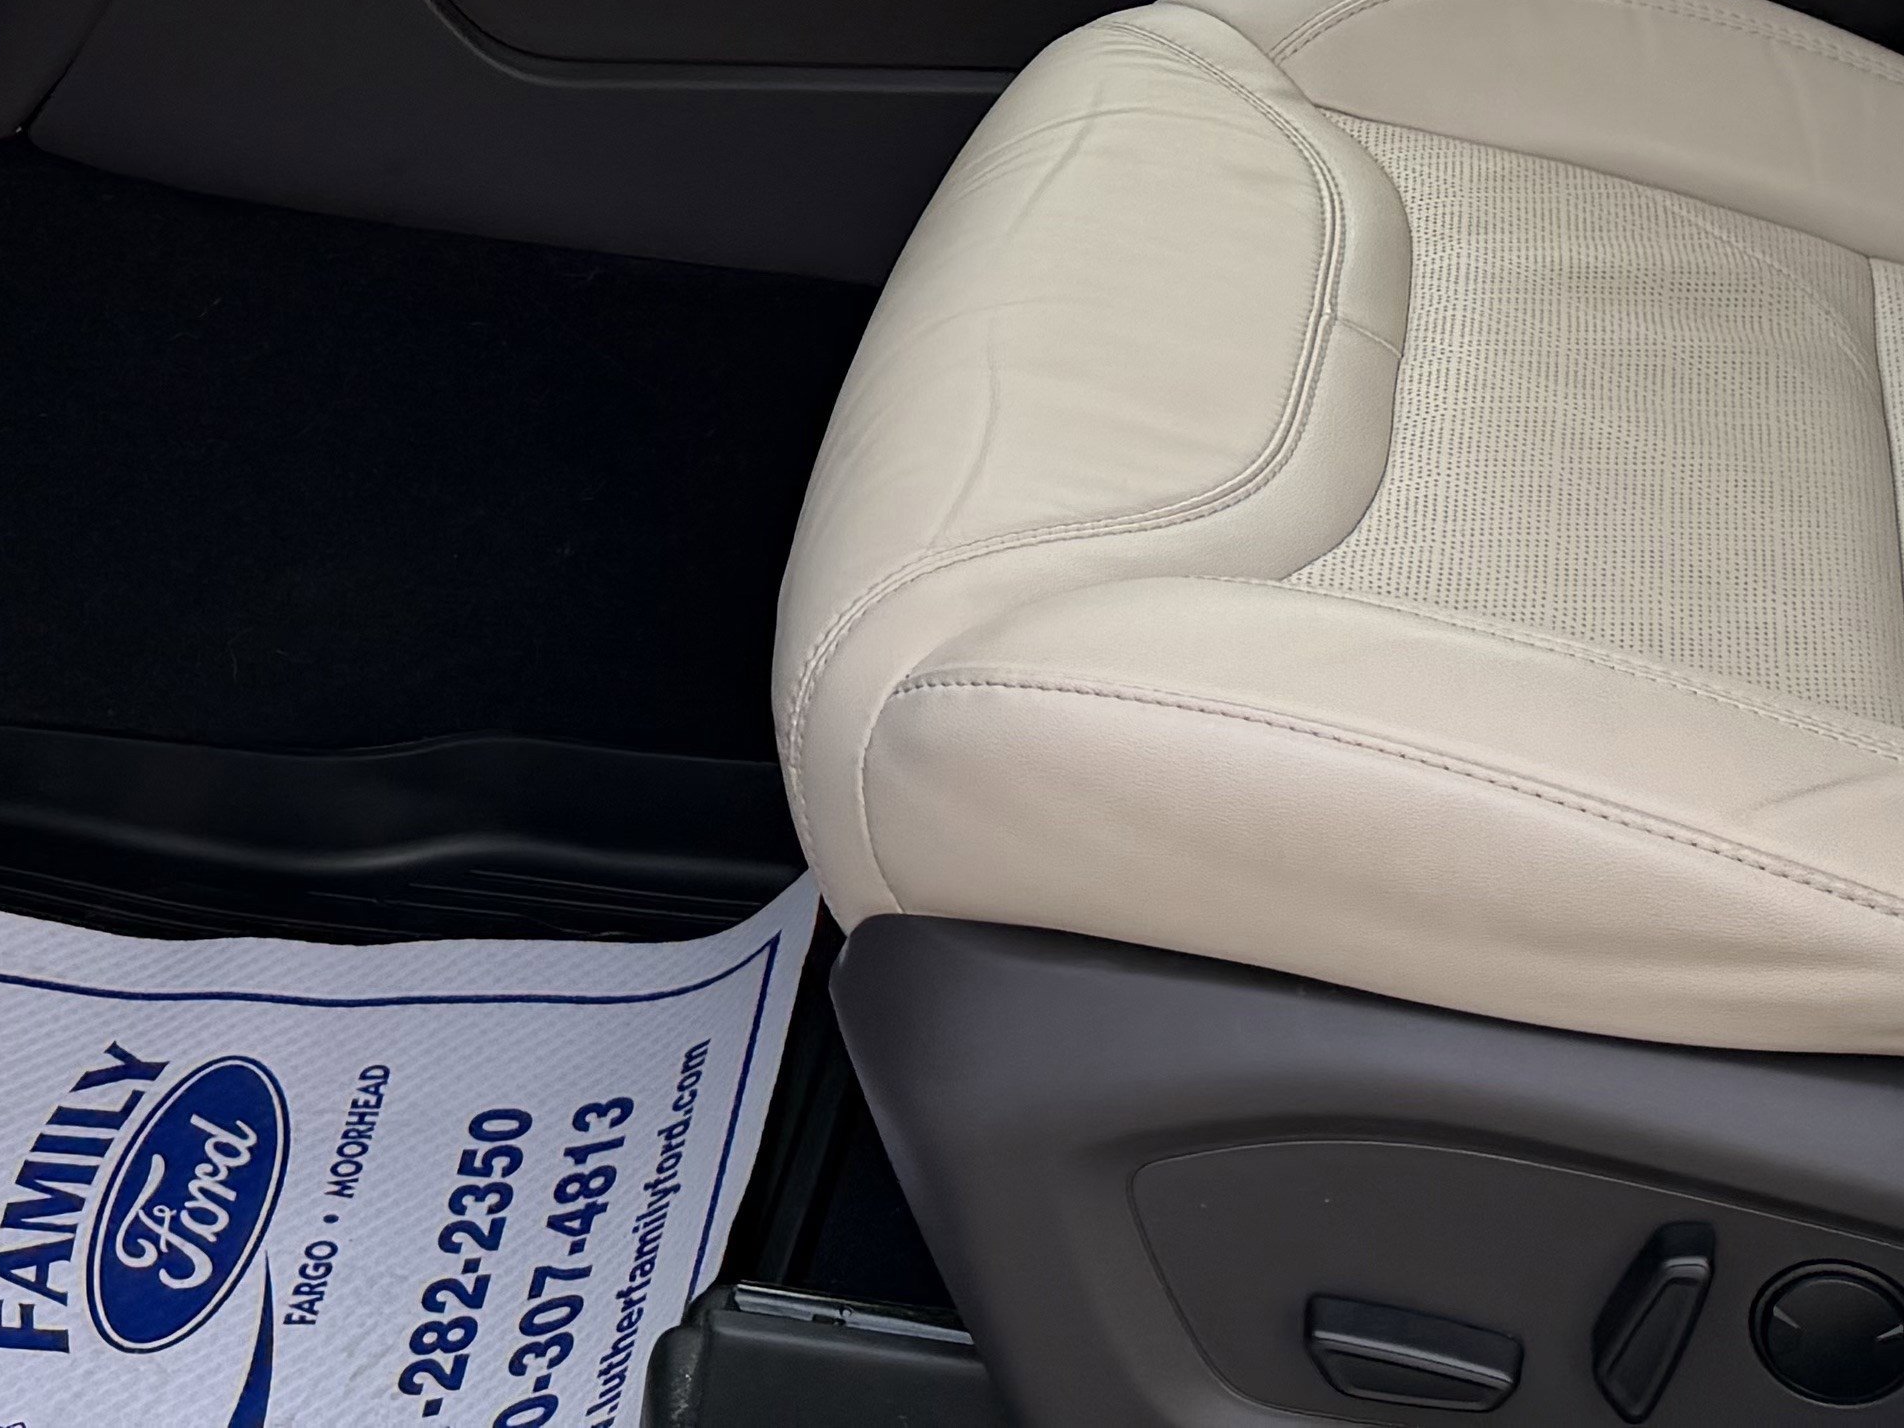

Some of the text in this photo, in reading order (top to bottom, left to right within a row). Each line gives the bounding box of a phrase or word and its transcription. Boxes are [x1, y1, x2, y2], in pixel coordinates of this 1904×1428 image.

[282, 1062, 392, 1326] FARGO MOORHEAD
[398, 1106, 534, 1419] -282-2350
